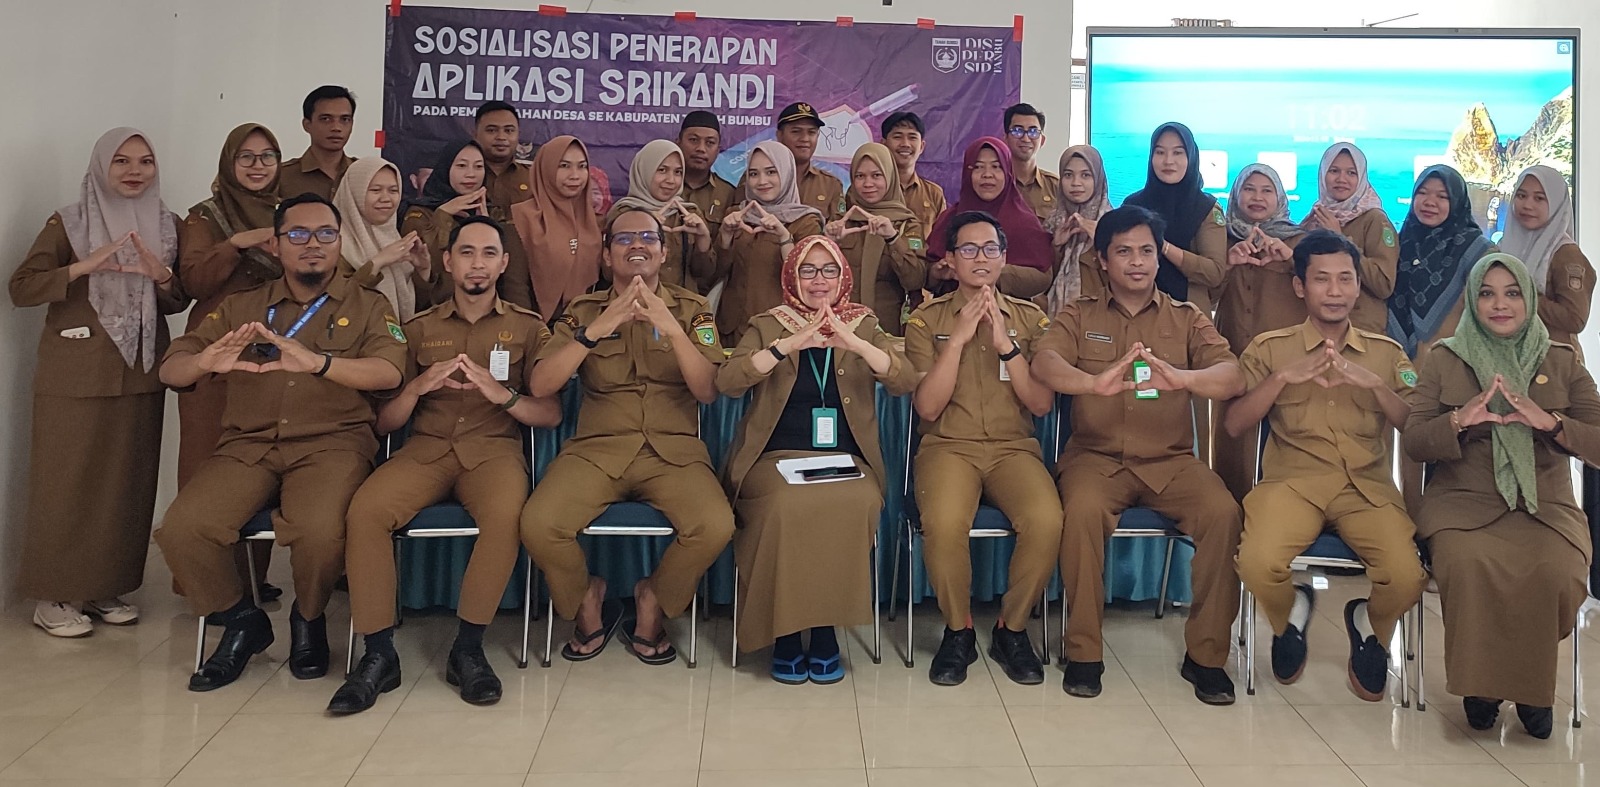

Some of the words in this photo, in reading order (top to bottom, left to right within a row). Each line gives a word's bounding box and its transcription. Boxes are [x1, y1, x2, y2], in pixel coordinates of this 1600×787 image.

[414, 26, 599, 59] SOSIALISASI
[610, 33, 777, 65] PENERAPAN
[965, 37, 993, 50] DIS
[412, 63, 583, 103] APLIKASI
[599, 69, 774, 109] SRIKANDI
[413, 105, 448, 116] PADA
[553, 109, 586, 121] DESA
[588, 111, 603, 122] SE
[605, 111, 680, 124] KABUPATEN
[727, 114, 772, 126] BUMBU
